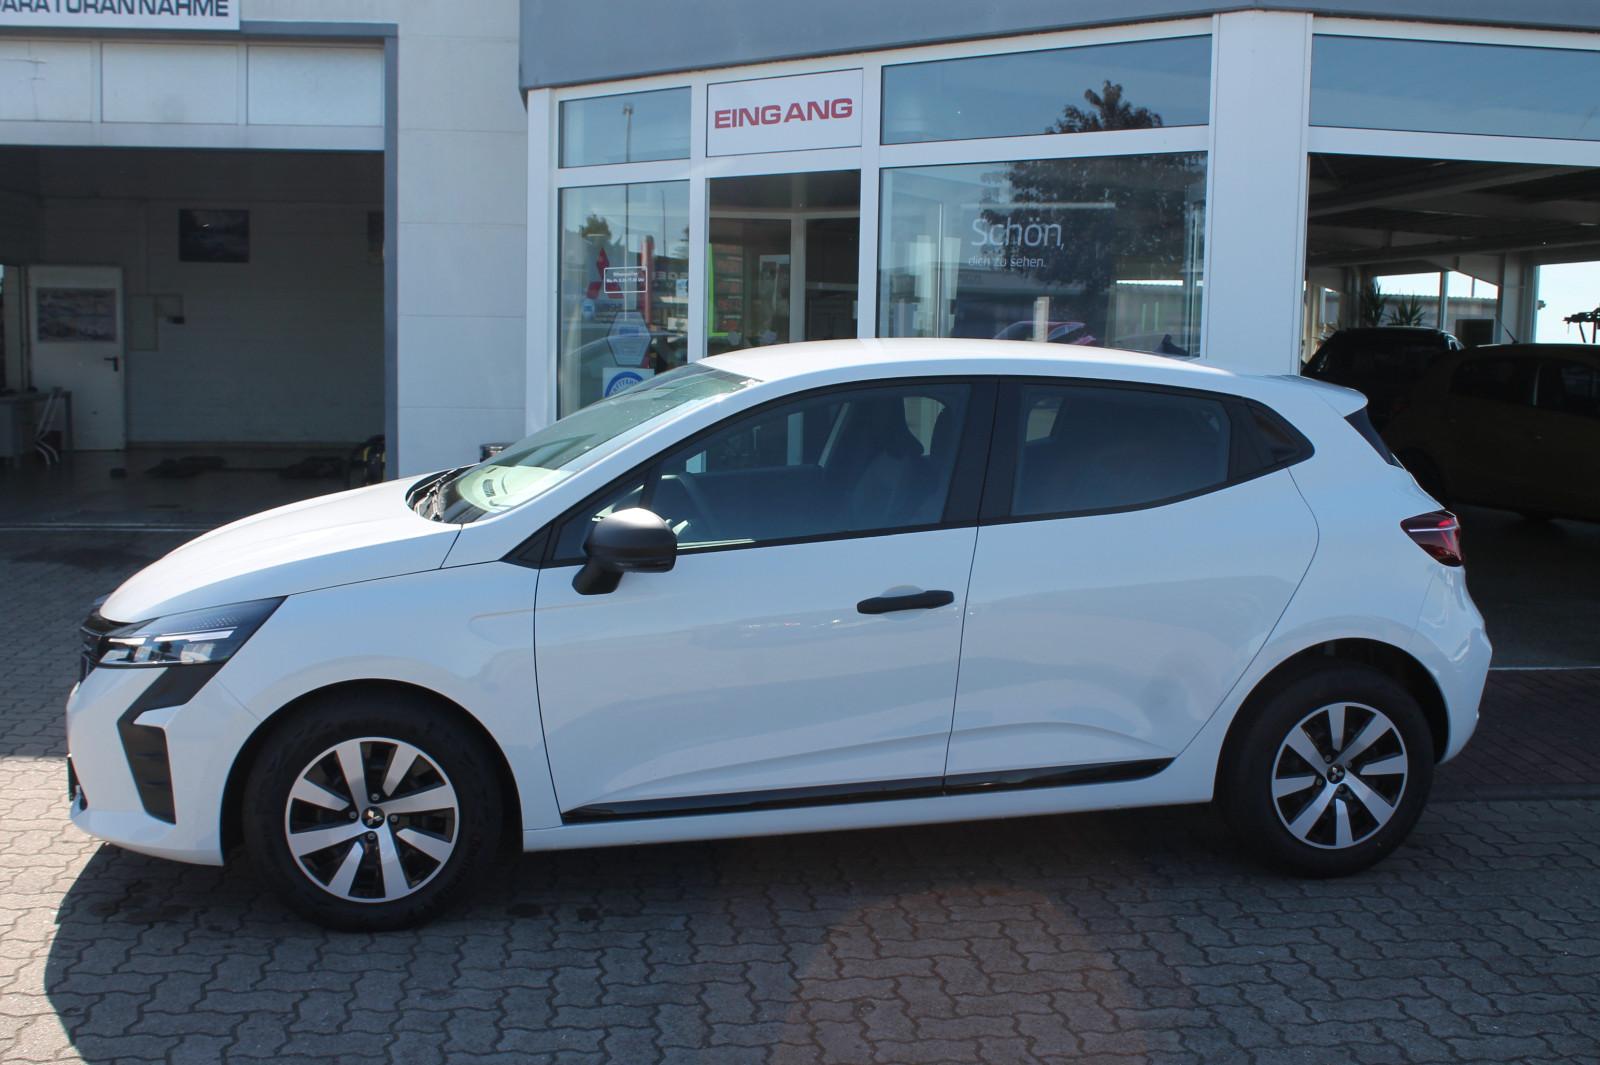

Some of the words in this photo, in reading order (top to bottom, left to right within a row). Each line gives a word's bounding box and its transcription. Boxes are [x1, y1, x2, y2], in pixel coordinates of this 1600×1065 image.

[0, 0, 229, 16] ARATURANNAHME
[714, 98, 853, 129] EINGANG
[970, 217, 1064, 250] Schön,
[993, 257, 1007, 267] zu
[1009, 256, 1047, 268] sehen.
